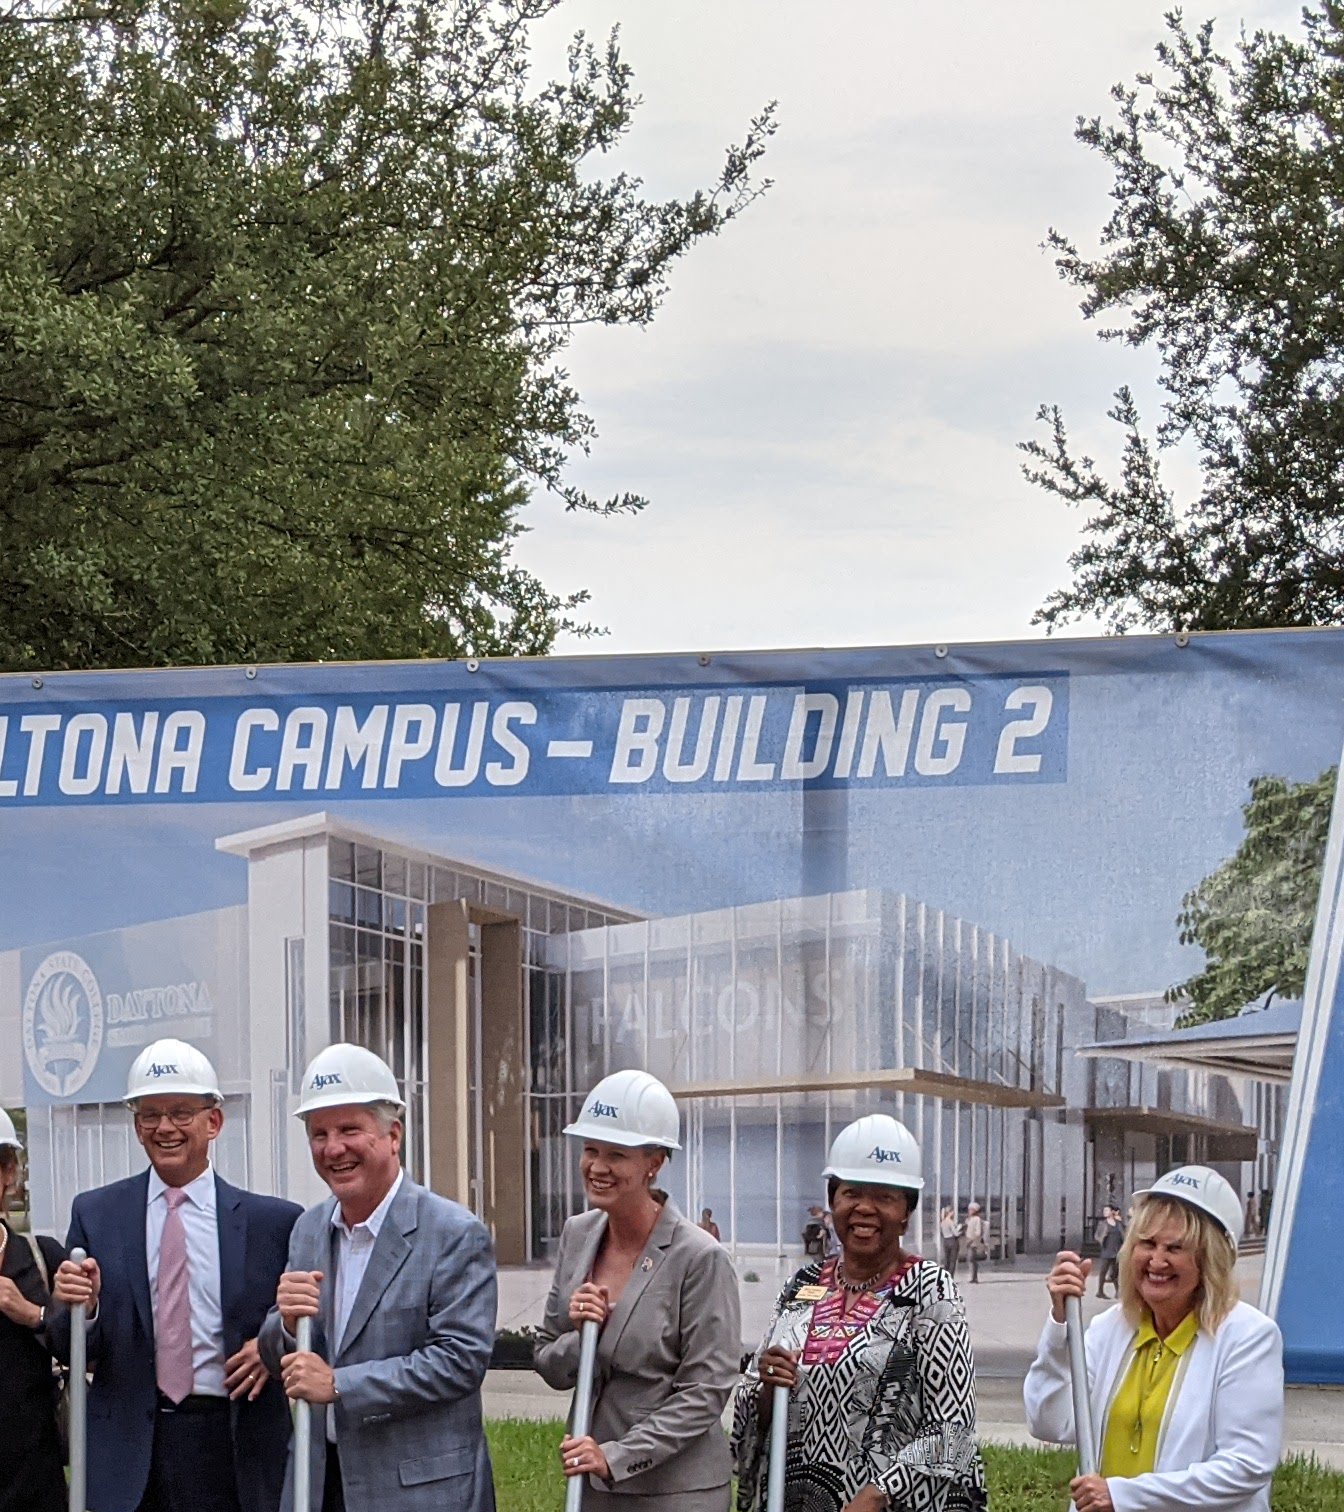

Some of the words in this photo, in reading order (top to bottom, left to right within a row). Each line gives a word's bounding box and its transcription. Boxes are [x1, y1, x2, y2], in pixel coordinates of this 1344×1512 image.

[228, 701, 537, 794] CAMPUS
[608, 687, 971, 784] BUILDING
[993, 685, 1054, 775] 2
[106, 980, 214, 1024] DAYTONA
[591, 970, 844, 1046] FALCONS
